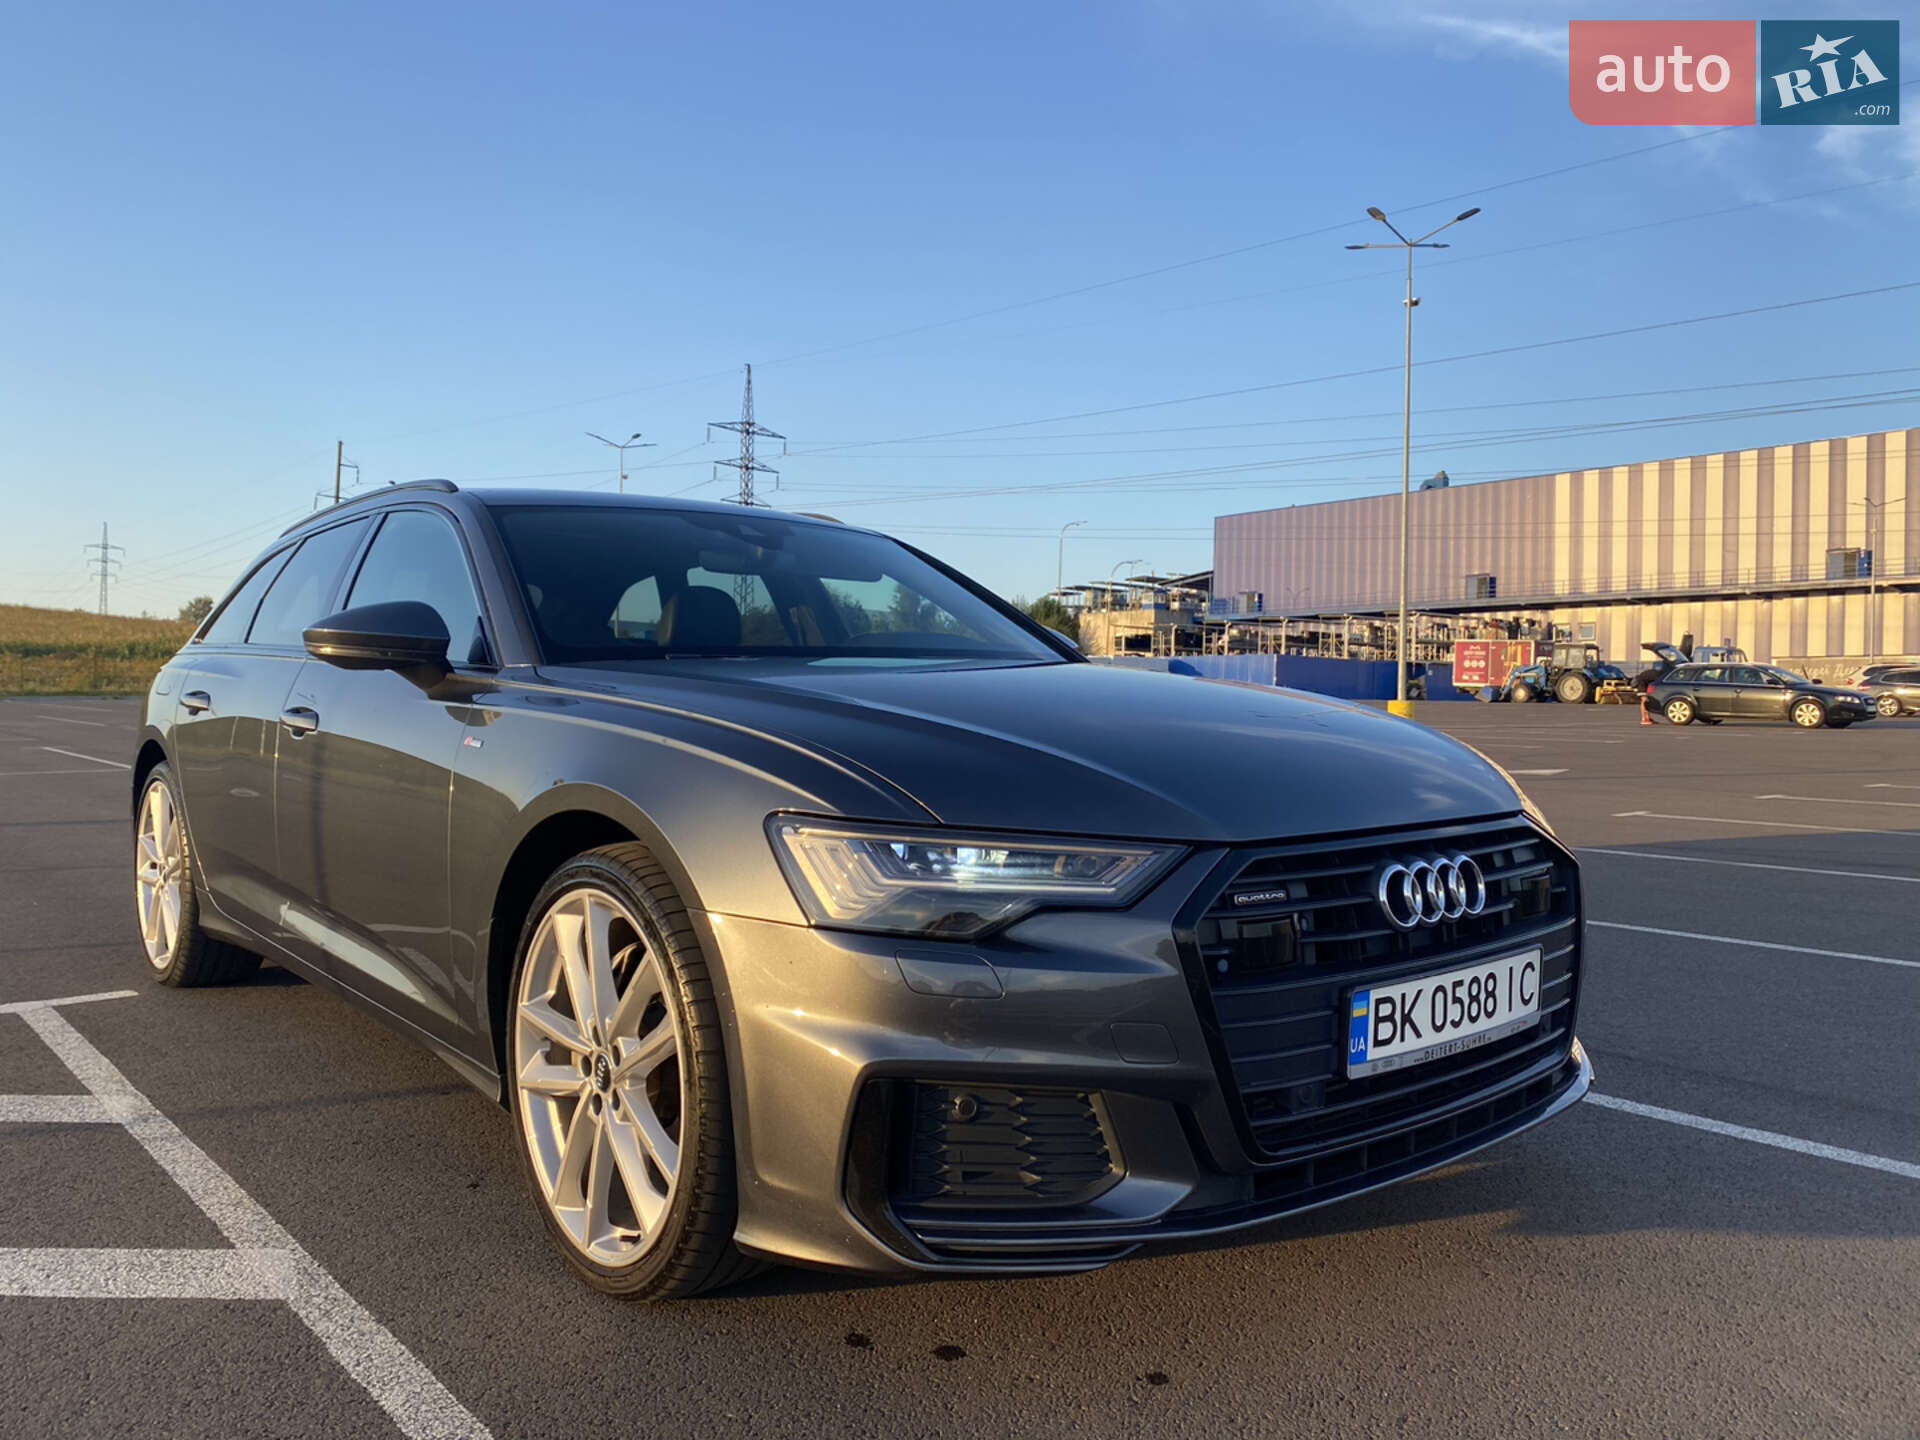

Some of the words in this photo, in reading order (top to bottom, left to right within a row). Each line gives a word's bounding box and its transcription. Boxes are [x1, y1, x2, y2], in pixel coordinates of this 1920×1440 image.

[1373, 988, 1423, 1049] BK
[1431, 972, 1497, 1034] 0588
[1508, 961, 1536, 1012] IC
[1351, 1036, 1366, 1054] UA
